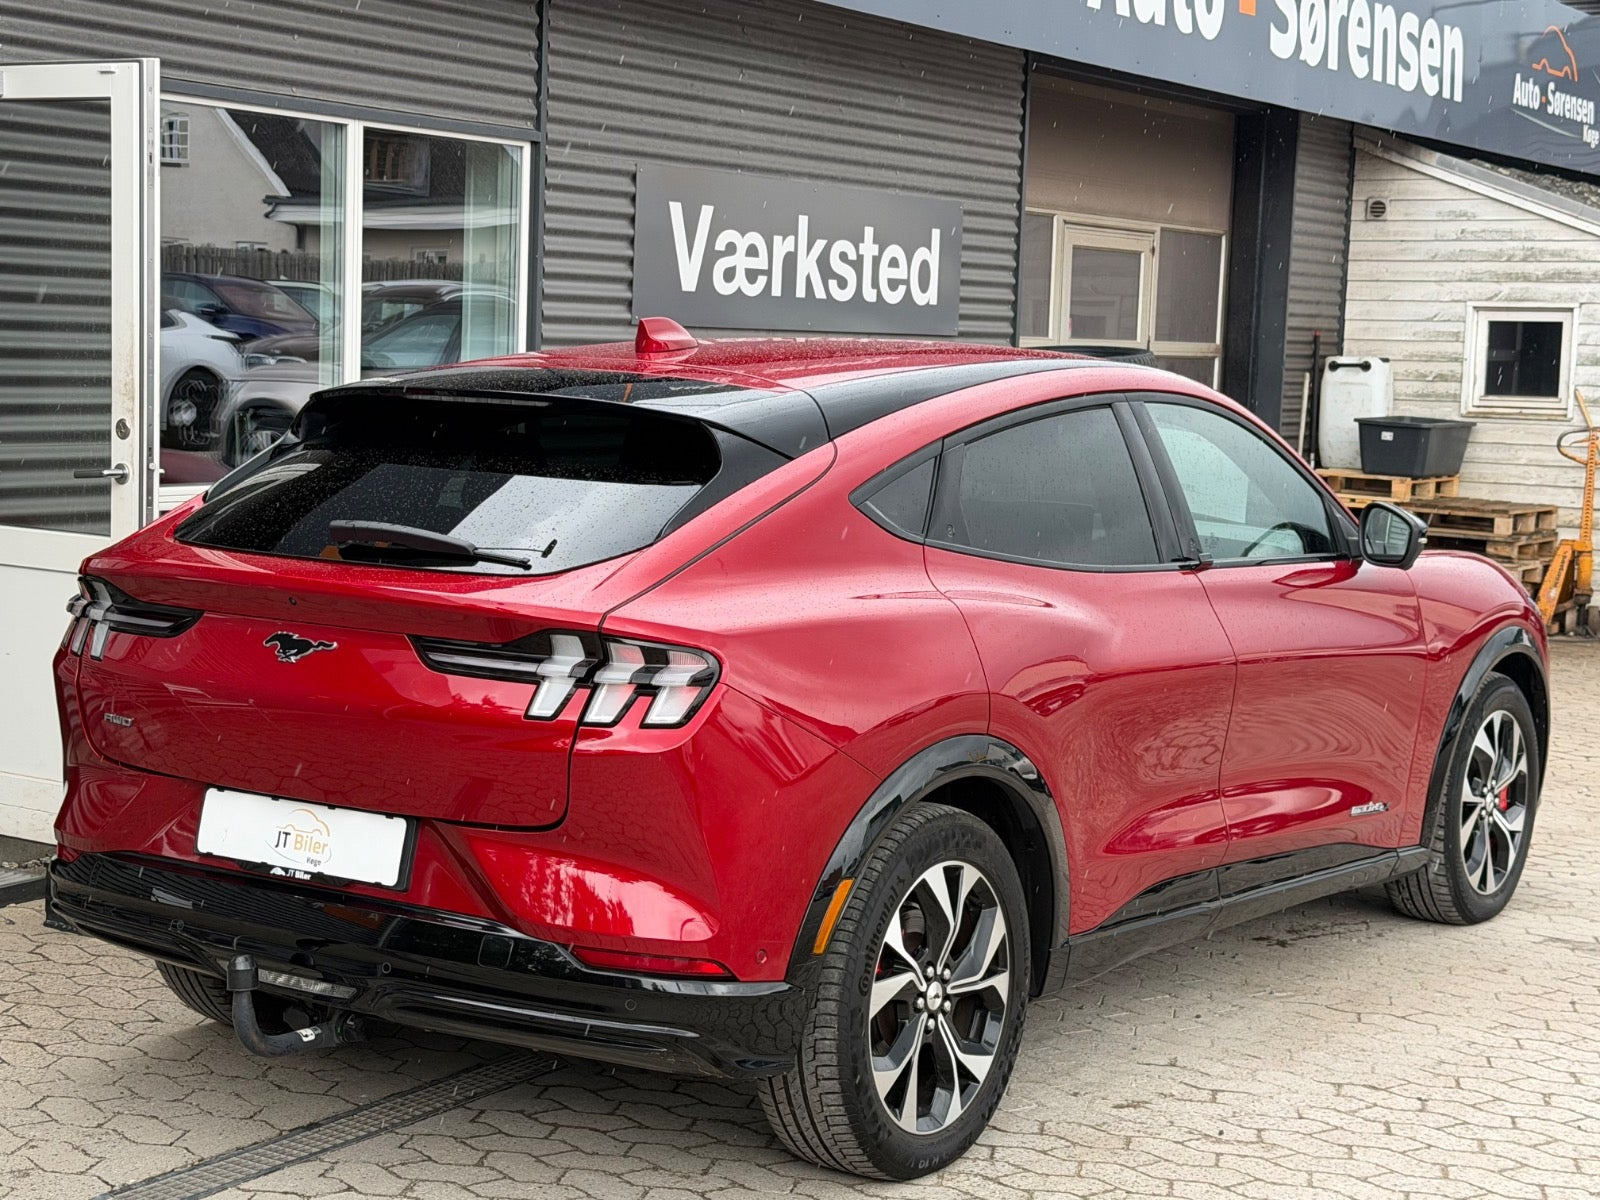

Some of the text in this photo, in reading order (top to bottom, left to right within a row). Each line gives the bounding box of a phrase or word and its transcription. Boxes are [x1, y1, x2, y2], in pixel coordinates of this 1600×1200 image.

[1513, 73, 1595, 125] Auto Sørensen
[669, 201, 941, 306] Værksted
[275, 831, 328, 854] JT Biler
[287, 869, 295, 877] JT
